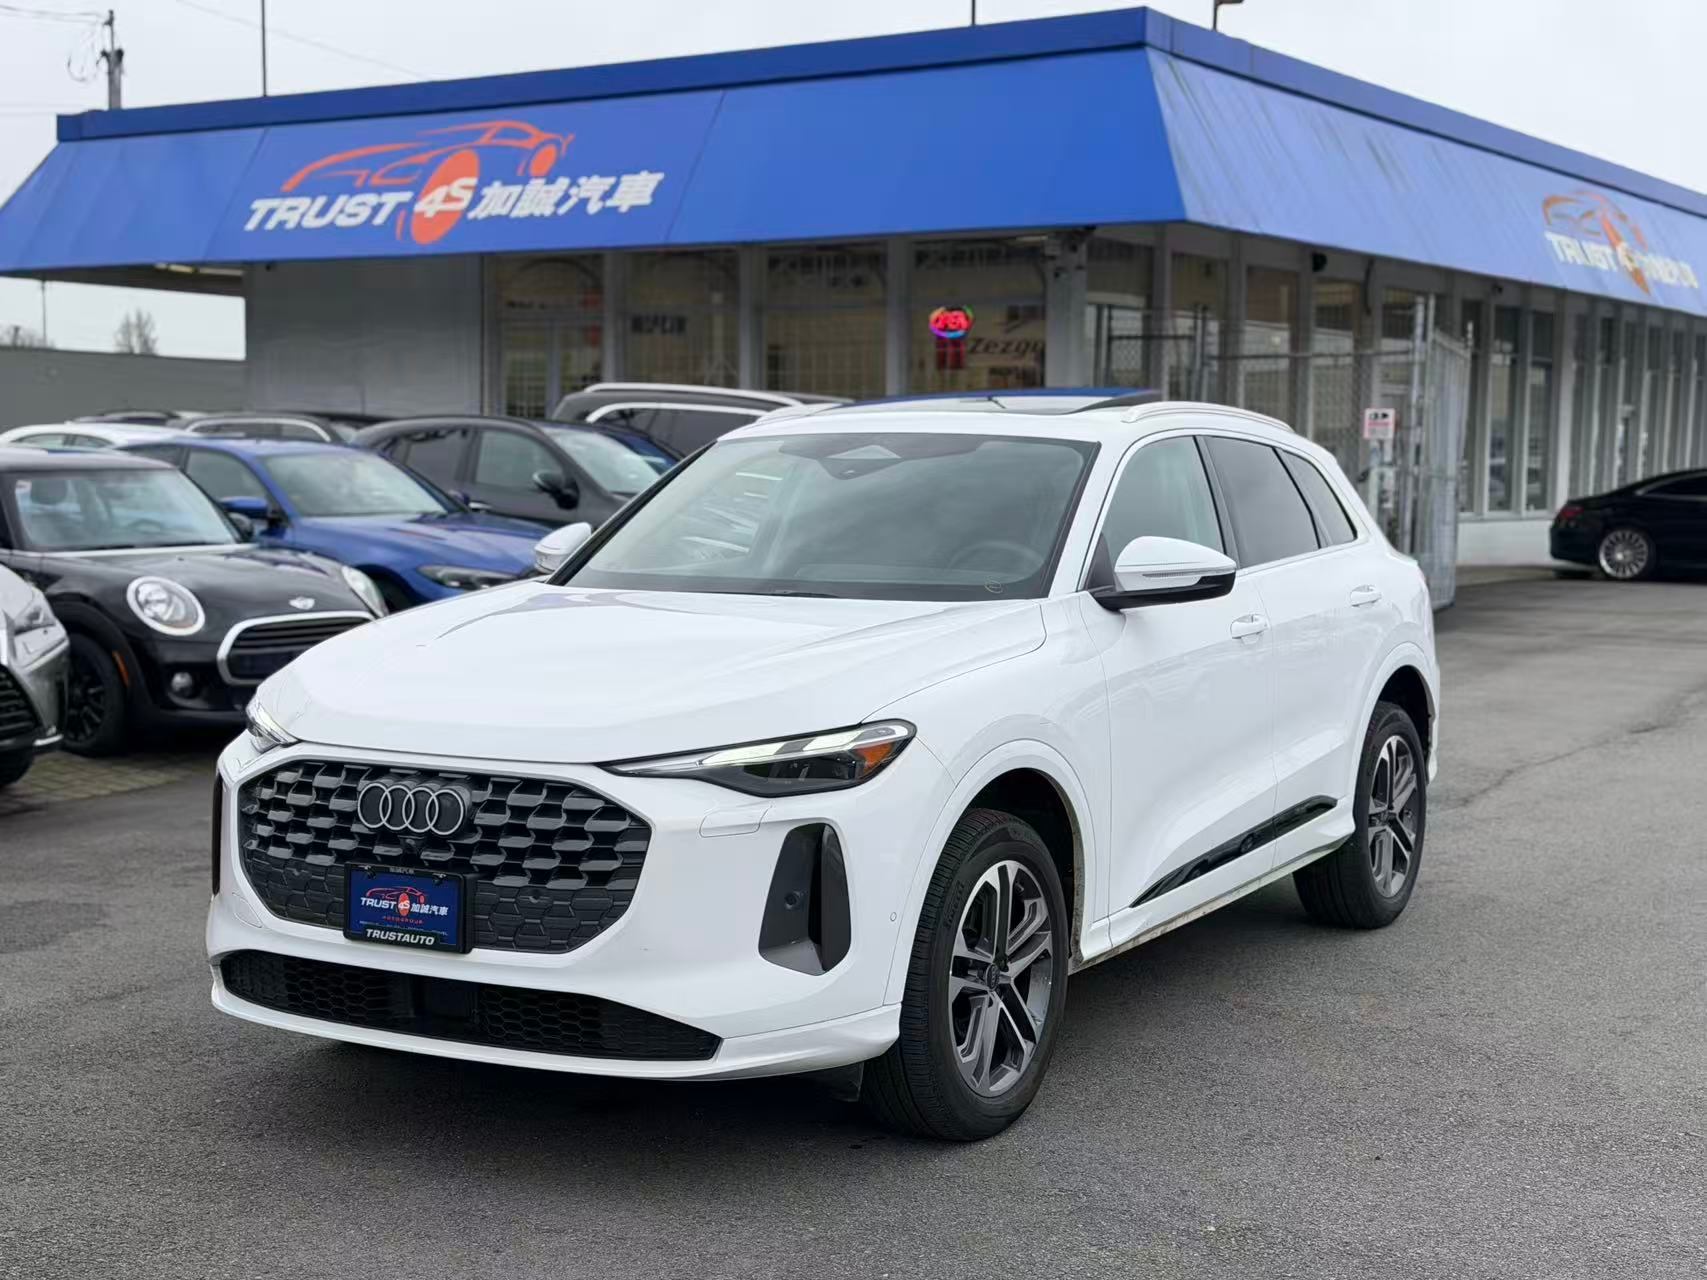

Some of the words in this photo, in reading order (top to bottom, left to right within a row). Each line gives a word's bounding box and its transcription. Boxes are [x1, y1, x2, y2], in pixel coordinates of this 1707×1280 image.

[244, 191, 413, 231] TRUST
[415, 178, 478, 218] 4S
[467, 171, 664, 220] 加誠汽車
[360, 897, 397, 909] TRUST
[366, 929, 434, 945] TRUSTAUTO
